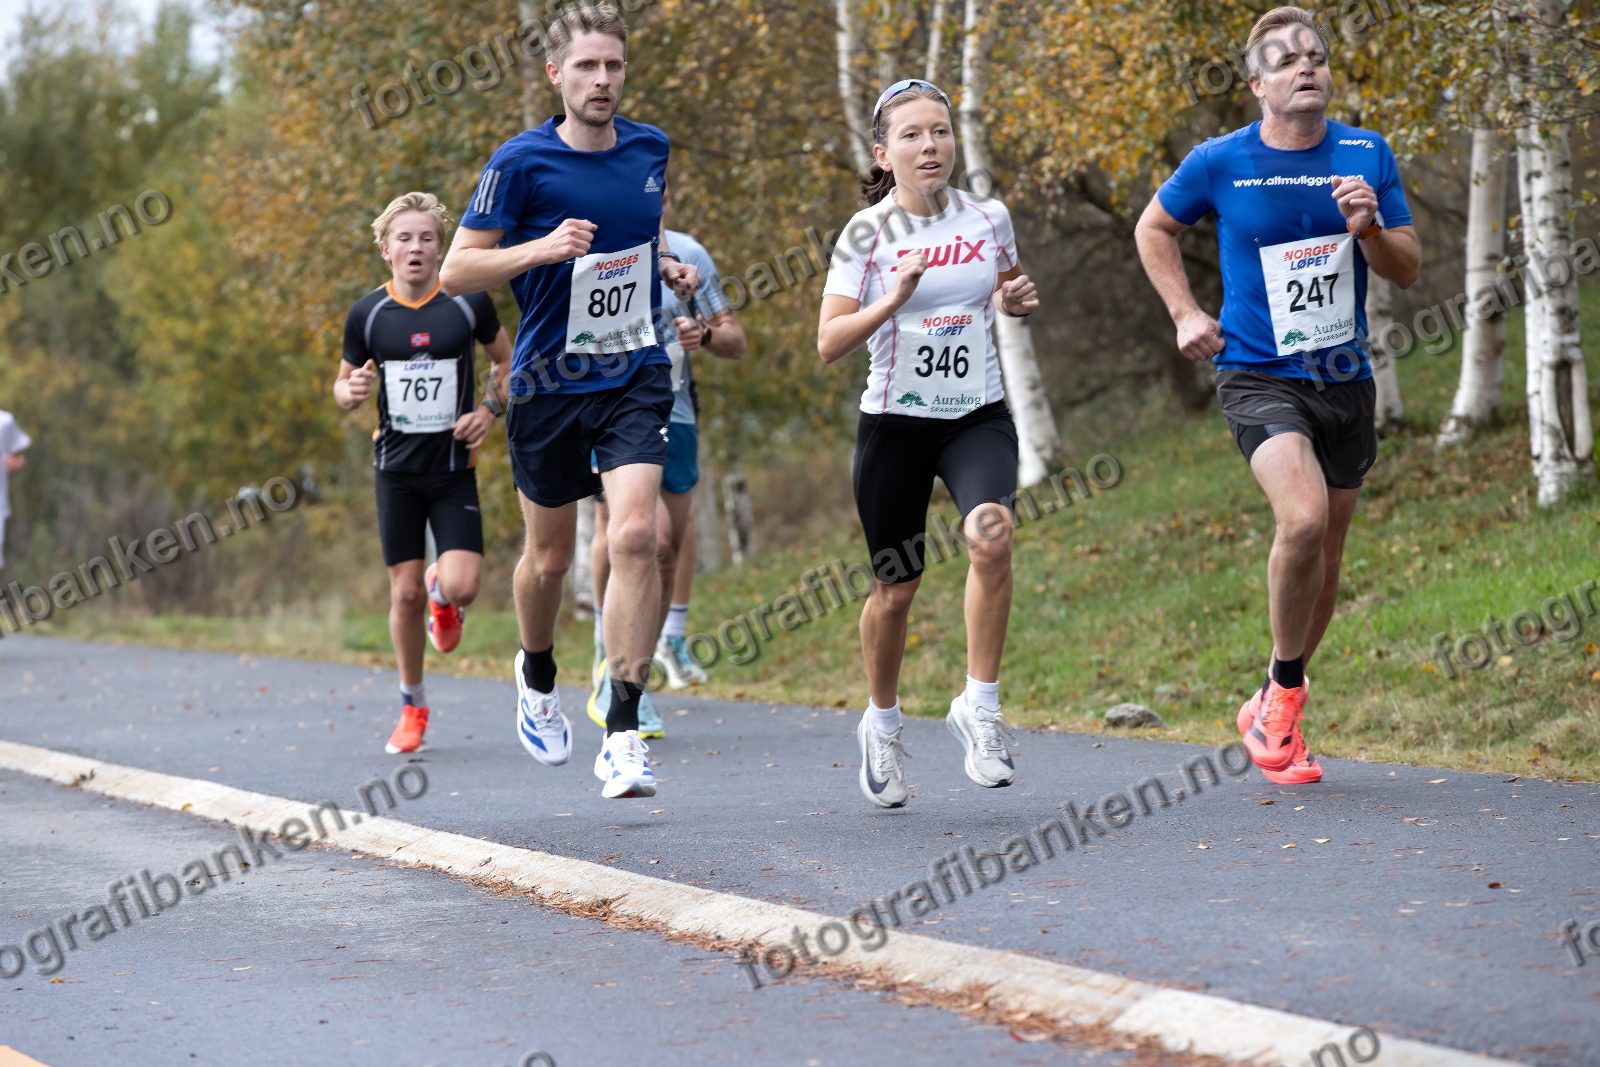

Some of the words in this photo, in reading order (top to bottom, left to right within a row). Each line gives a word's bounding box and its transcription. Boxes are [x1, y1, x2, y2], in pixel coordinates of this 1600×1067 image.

[1284, 243, 1338, 261] NORGES
[594, 254, 639, 271] NORGES
[1290, 255, 1330, 271] LØPET
[597, 265, 632, 281] LØPET
[588, 282, 637, 318] 807
[1286, 273, 1339, 313] 247
[922, 315, 973, 328] NORGES
[1313, 317, 1354, 336] Aurskog
[927, 325, 965, 336] LØPET
[915, 345, 969, 378] 346
[399, 377, 443, 402] 767
[931, 394, 981, 408] Aurskog
